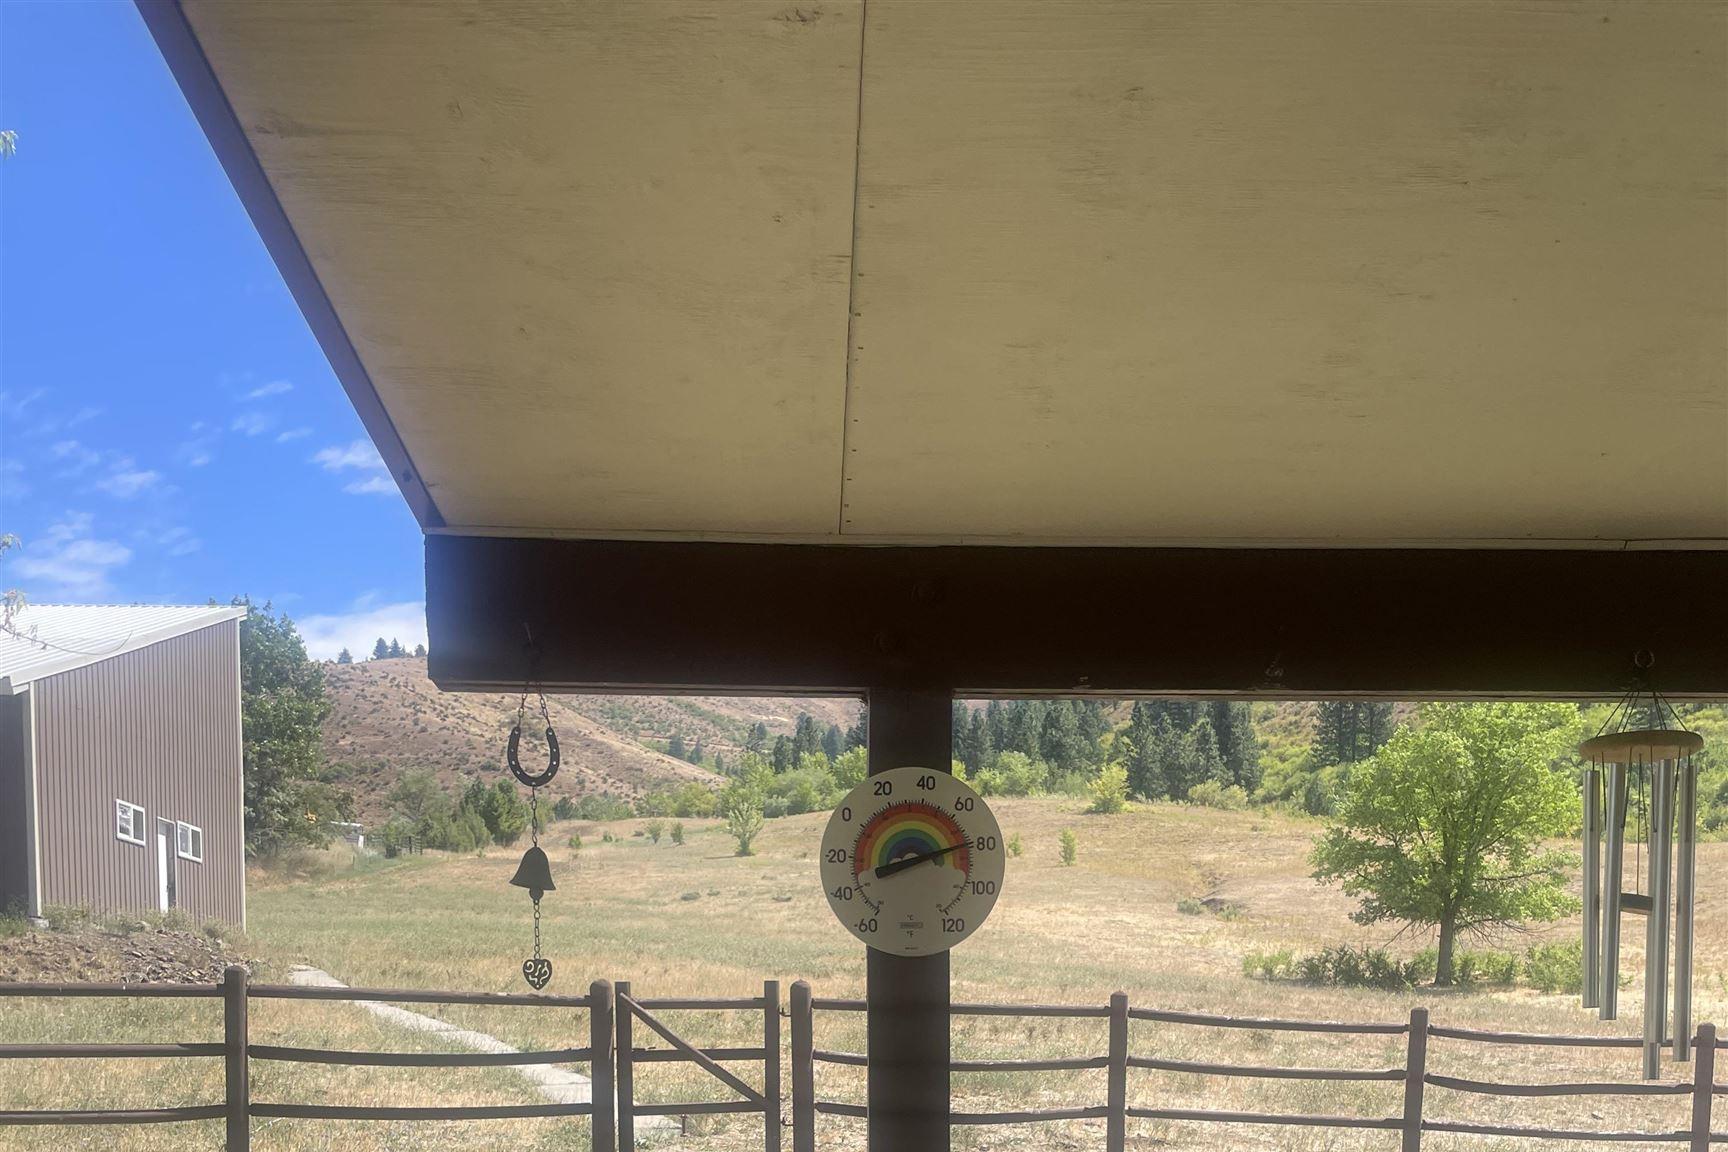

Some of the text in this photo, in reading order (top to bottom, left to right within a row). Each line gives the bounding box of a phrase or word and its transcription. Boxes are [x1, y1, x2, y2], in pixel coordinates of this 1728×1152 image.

[874, 781, 892, 796] 20
[917, 776, 936, 790] 40
[954, 797, 974, 811] 60
[842, 807, 852, 821] 0
[976, 837, 996, 850] 80
[825, 849, 846, 863] -20
[830, 886, 853, 900] -40
[971, 881, 995, 894] 100
[854, 919, 878, 932] -60
[942, 919, 965, 932] 120
